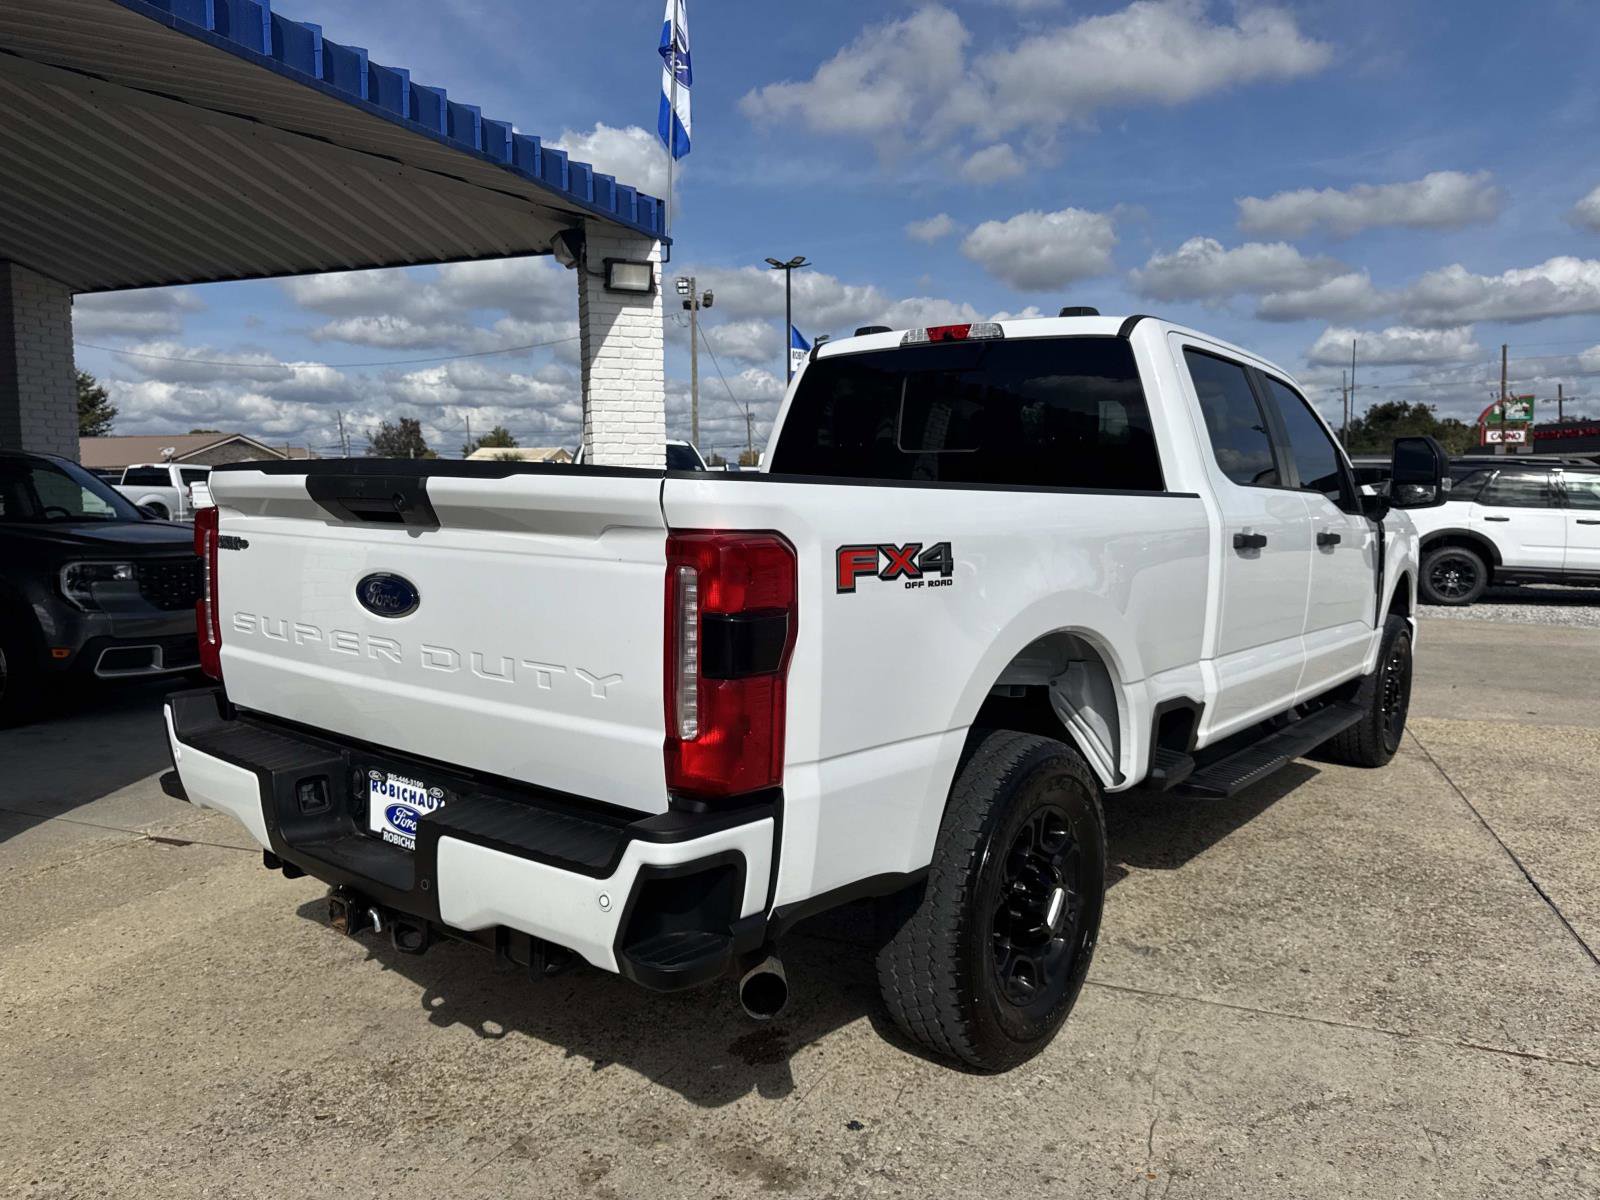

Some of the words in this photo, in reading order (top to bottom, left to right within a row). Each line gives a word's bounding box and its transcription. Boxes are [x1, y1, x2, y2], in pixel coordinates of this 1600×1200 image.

[1490, 431, 1521, 442] CAINO
[835, 541, 954, 595] FX4
[366, 581, 401, 608] Ford
[904, 581, 925, 590] OFF
[927, 579, 953, 589] ROAD
[233, 611, 402, 664] SUPER
[420, 643, 624, 700] DUTY
[383, 830, 416, 851] ROBICHA
